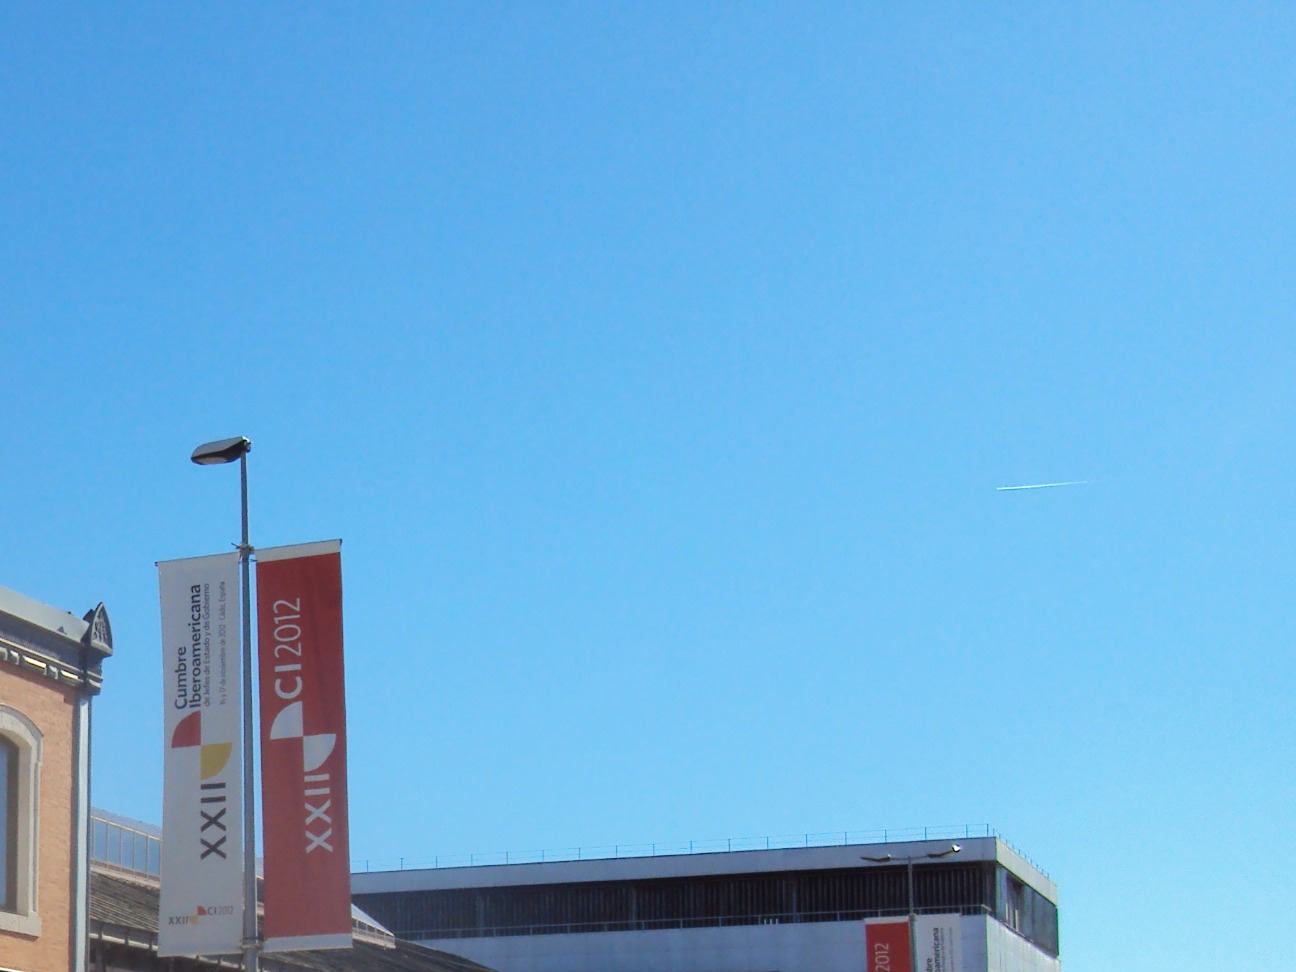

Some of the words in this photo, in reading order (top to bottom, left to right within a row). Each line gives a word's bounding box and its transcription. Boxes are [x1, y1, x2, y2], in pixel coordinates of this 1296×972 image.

[202, 583, 210, 620] Gobierno
[203, 621, 211, 631] de
[273, 598, 302, 658] 2012
[188, 584, 202, 708] Iberoamericana
[203, 638, 211, 664] Estado
[174, 646, 188, 709] Cumbre
[203, 665, 211, 675] de
[203, 677, 211, 695] Jefes
[274, 664, 302, 700] CI
[203, 697, 211, 707] de
[200, 782, 227, 860] XXII
[303, 774, 333, 854] XXII
[168, 915, 189, 926] XXII
[874, 942, 889, 972] 2012
